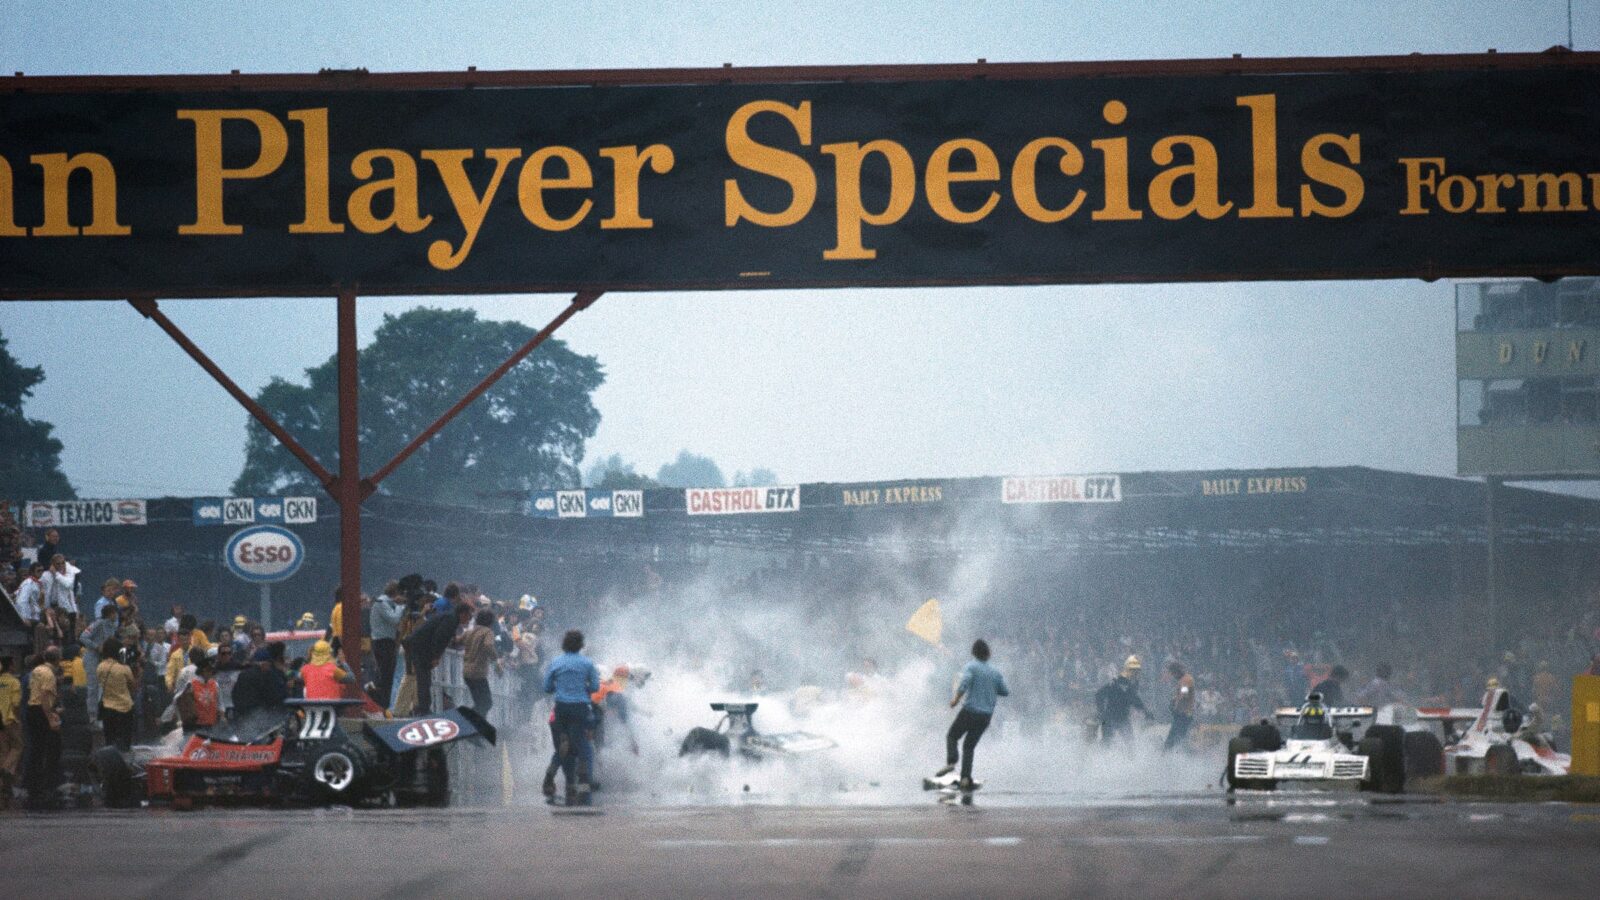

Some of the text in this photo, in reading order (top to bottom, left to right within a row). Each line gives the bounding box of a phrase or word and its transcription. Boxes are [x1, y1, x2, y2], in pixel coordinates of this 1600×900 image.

[0, 94, 1600, 271] n Player Specials Form
[884, 486, 943, 504] EXPRESS
[1084, 478, 1116, 500] GTX
[1246, 477, 1307, 495] EXPRESS
[286, 500, 315, 520] GKN
[559, 494, 585, 513] GKN
[615, 494, 641, 513] GKN
[690, 488, 795, 512] CASTROL GTX
[56, 501, 114, 524] TEXACO
[225, 501, 253, 521] GKN
[240, 542, 293, 565] Esso
[404, 720, 452, 744] STP
